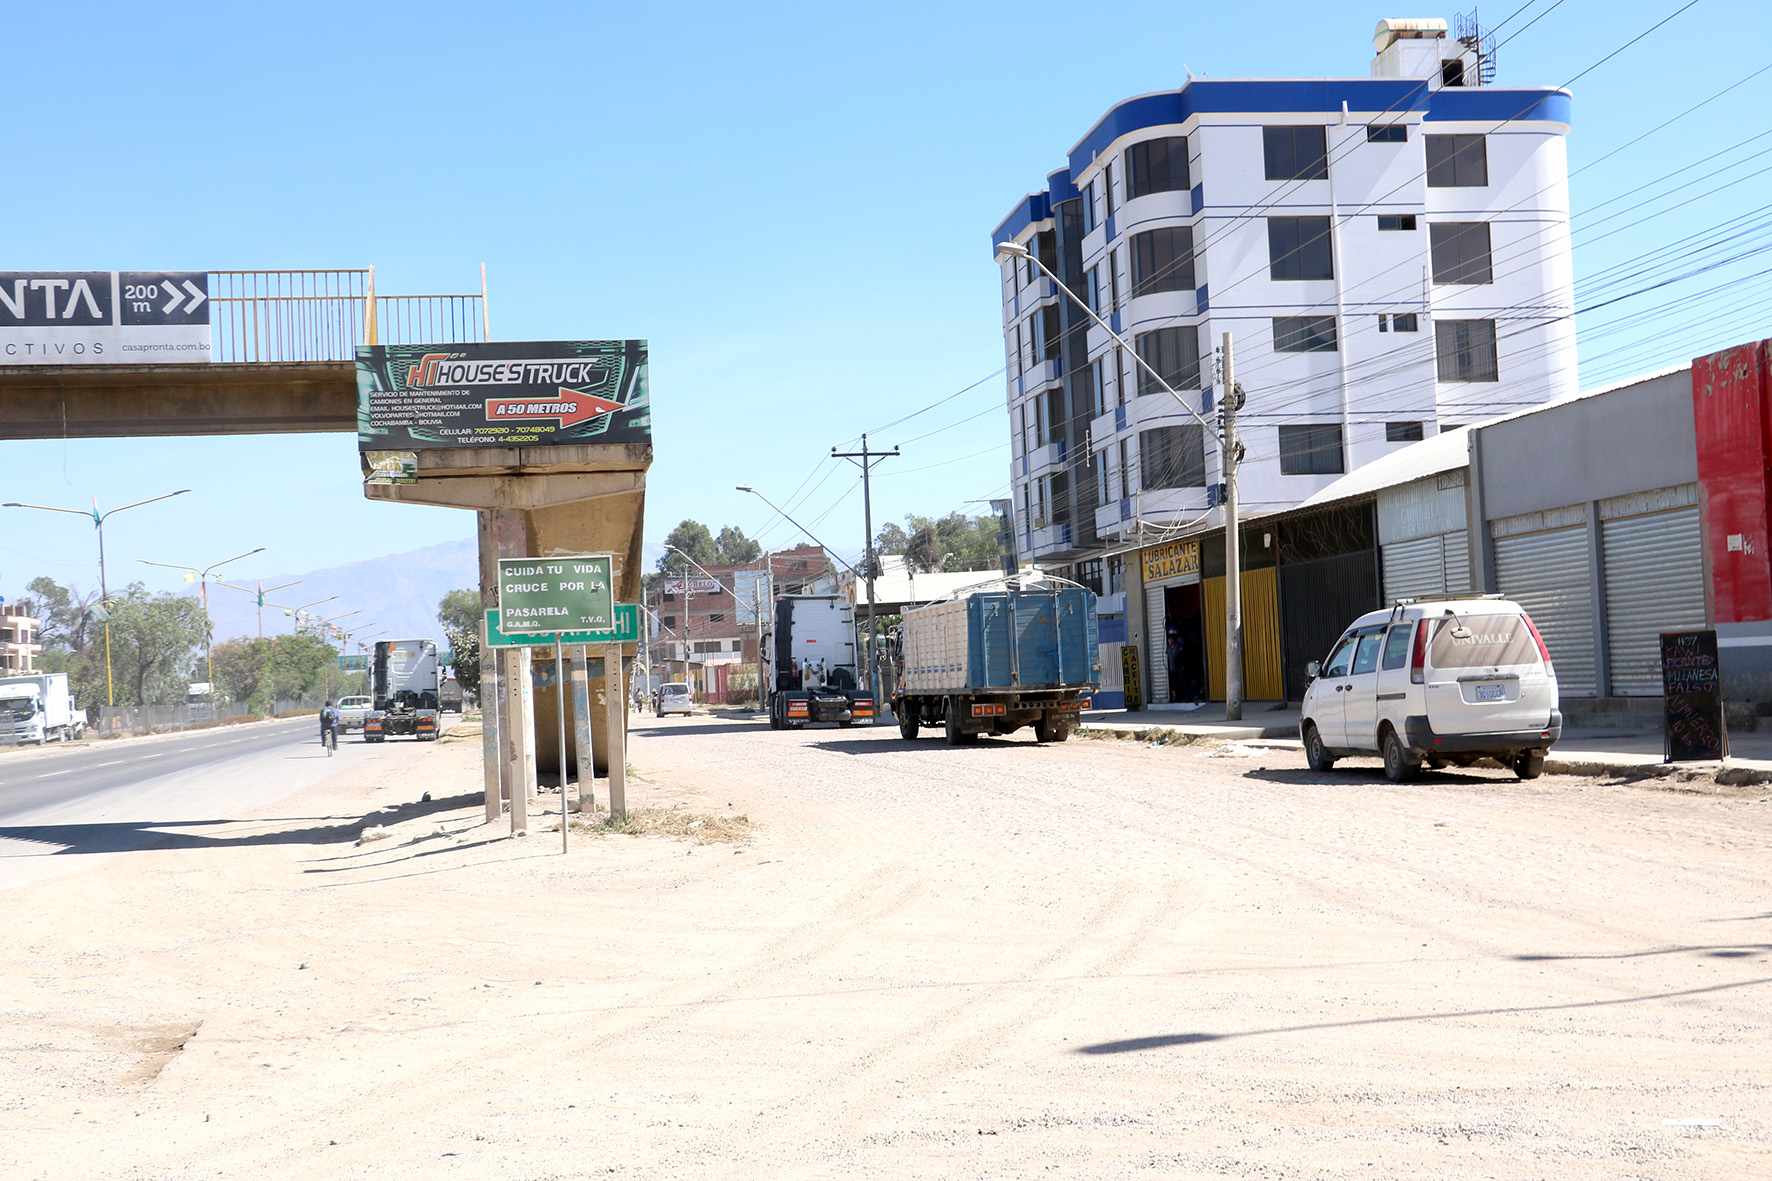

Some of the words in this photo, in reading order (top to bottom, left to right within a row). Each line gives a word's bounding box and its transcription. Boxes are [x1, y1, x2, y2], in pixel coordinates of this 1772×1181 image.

[124, 285, 158, 299] 200
[132, 301, 152, 313] m
[5, 342, 104, 355] CTIVOS
[121, 341, 211, 353] casapronta.com.bo
[526, 363, 593, 384] TRUCK
[496, 405, 506, 415] A
[507, 404, 525, 414] 50
[526, 402, 577, 414] METROS
[505, 566, 544, 576] CUIDA
[547, 565, 563, 574] TU
[574, 564, 602, 574] VIDA
[1148, 554, 1199, 579] SALAZAR
[505, 583, 549, 593] CRUCE
[560, 582, 584, 591] POR
[591, 581, 605, 591] LA
[506, 607, 569, 617] PASARELA
